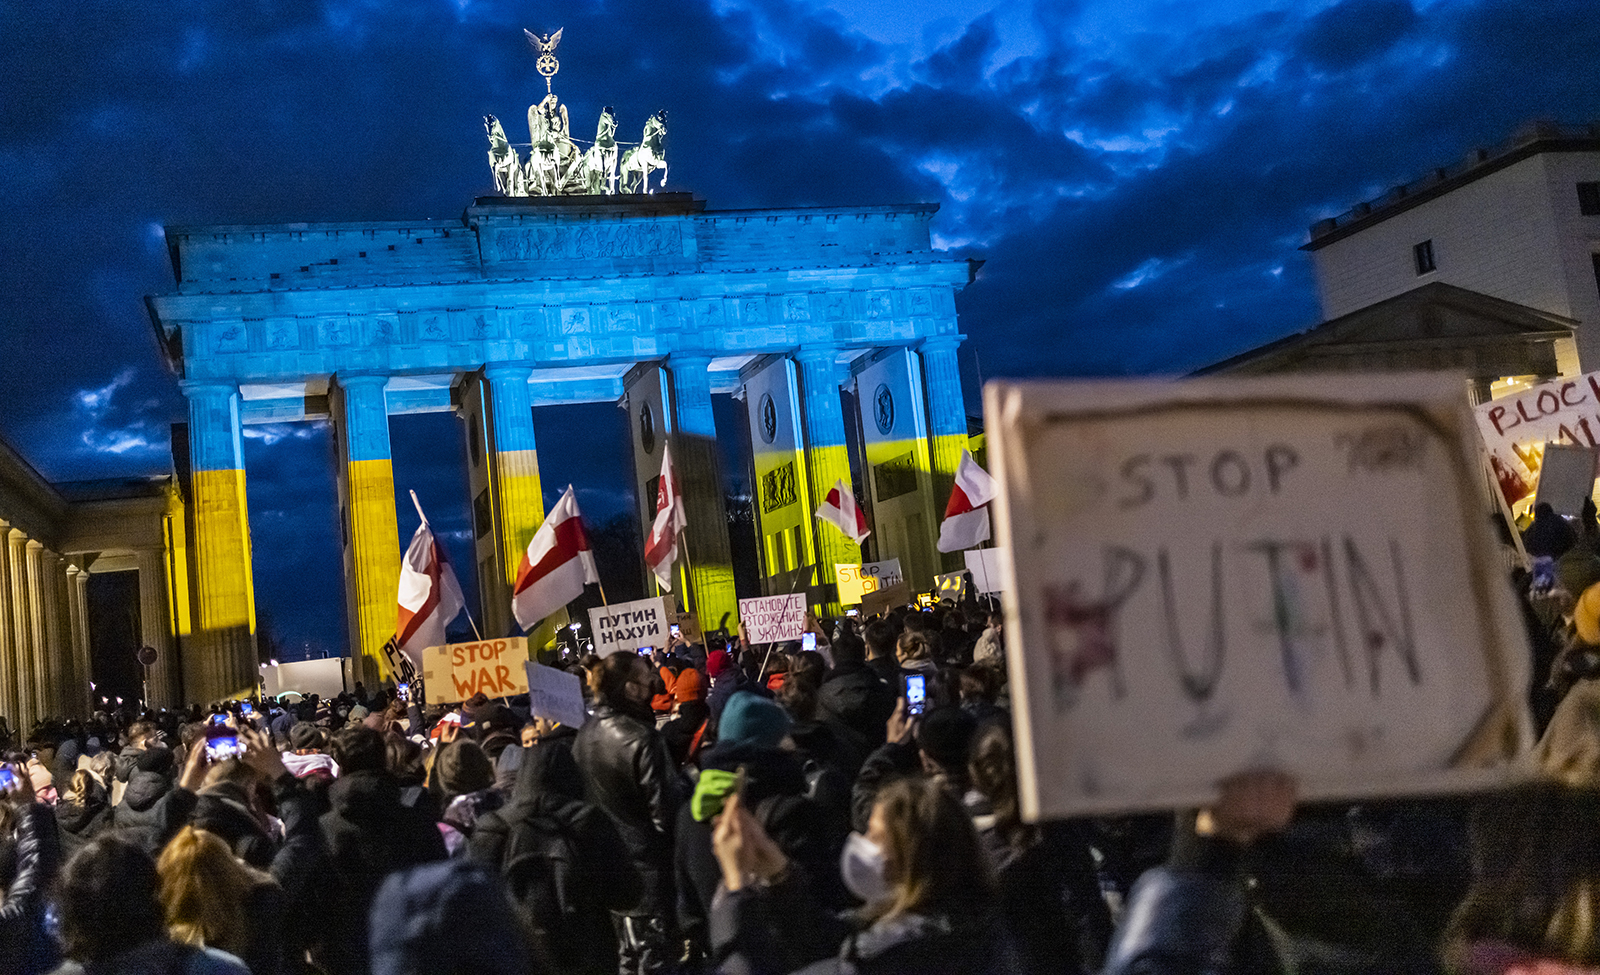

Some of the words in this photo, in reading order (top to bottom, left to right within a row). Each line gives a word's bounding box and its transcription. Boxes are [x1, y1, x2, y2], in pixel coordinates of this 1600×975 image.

[1117, 443, 1300, 508] STOP
[839, 565, 880, 584] STOP
[740, 596, 802, 616] ОСТАНОВИТЕ
[1101, 532, 1423, 704] PUTIN
[599, 608, 657, 629] ПУТИН
[743, 610, 803, 627] ВТОРЖЕНИЕ
[601, 621, 660, 645] НАХУЙ
[452, 641, 507, 666] STOP
[451, 665, 517, 698] WAR
